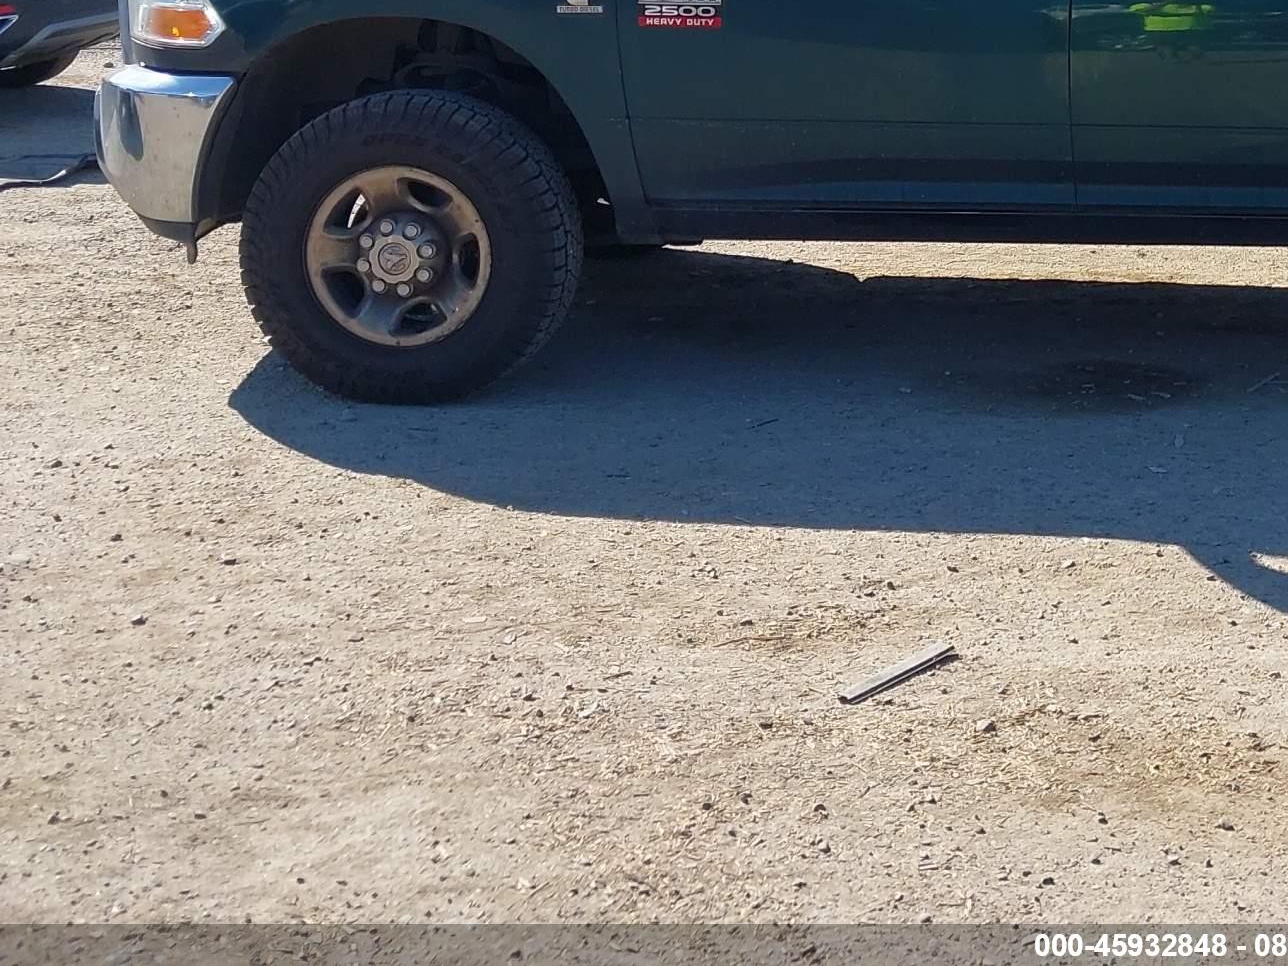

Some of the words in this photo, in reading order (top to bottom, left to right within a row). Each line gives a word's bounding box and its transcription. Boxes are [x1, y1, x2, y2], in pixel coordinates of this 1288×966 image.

[644, 5, 716, 17] 2500
[646, 18, 682, 26] HEAVY
[686, 18, 714, 26] DUTY
